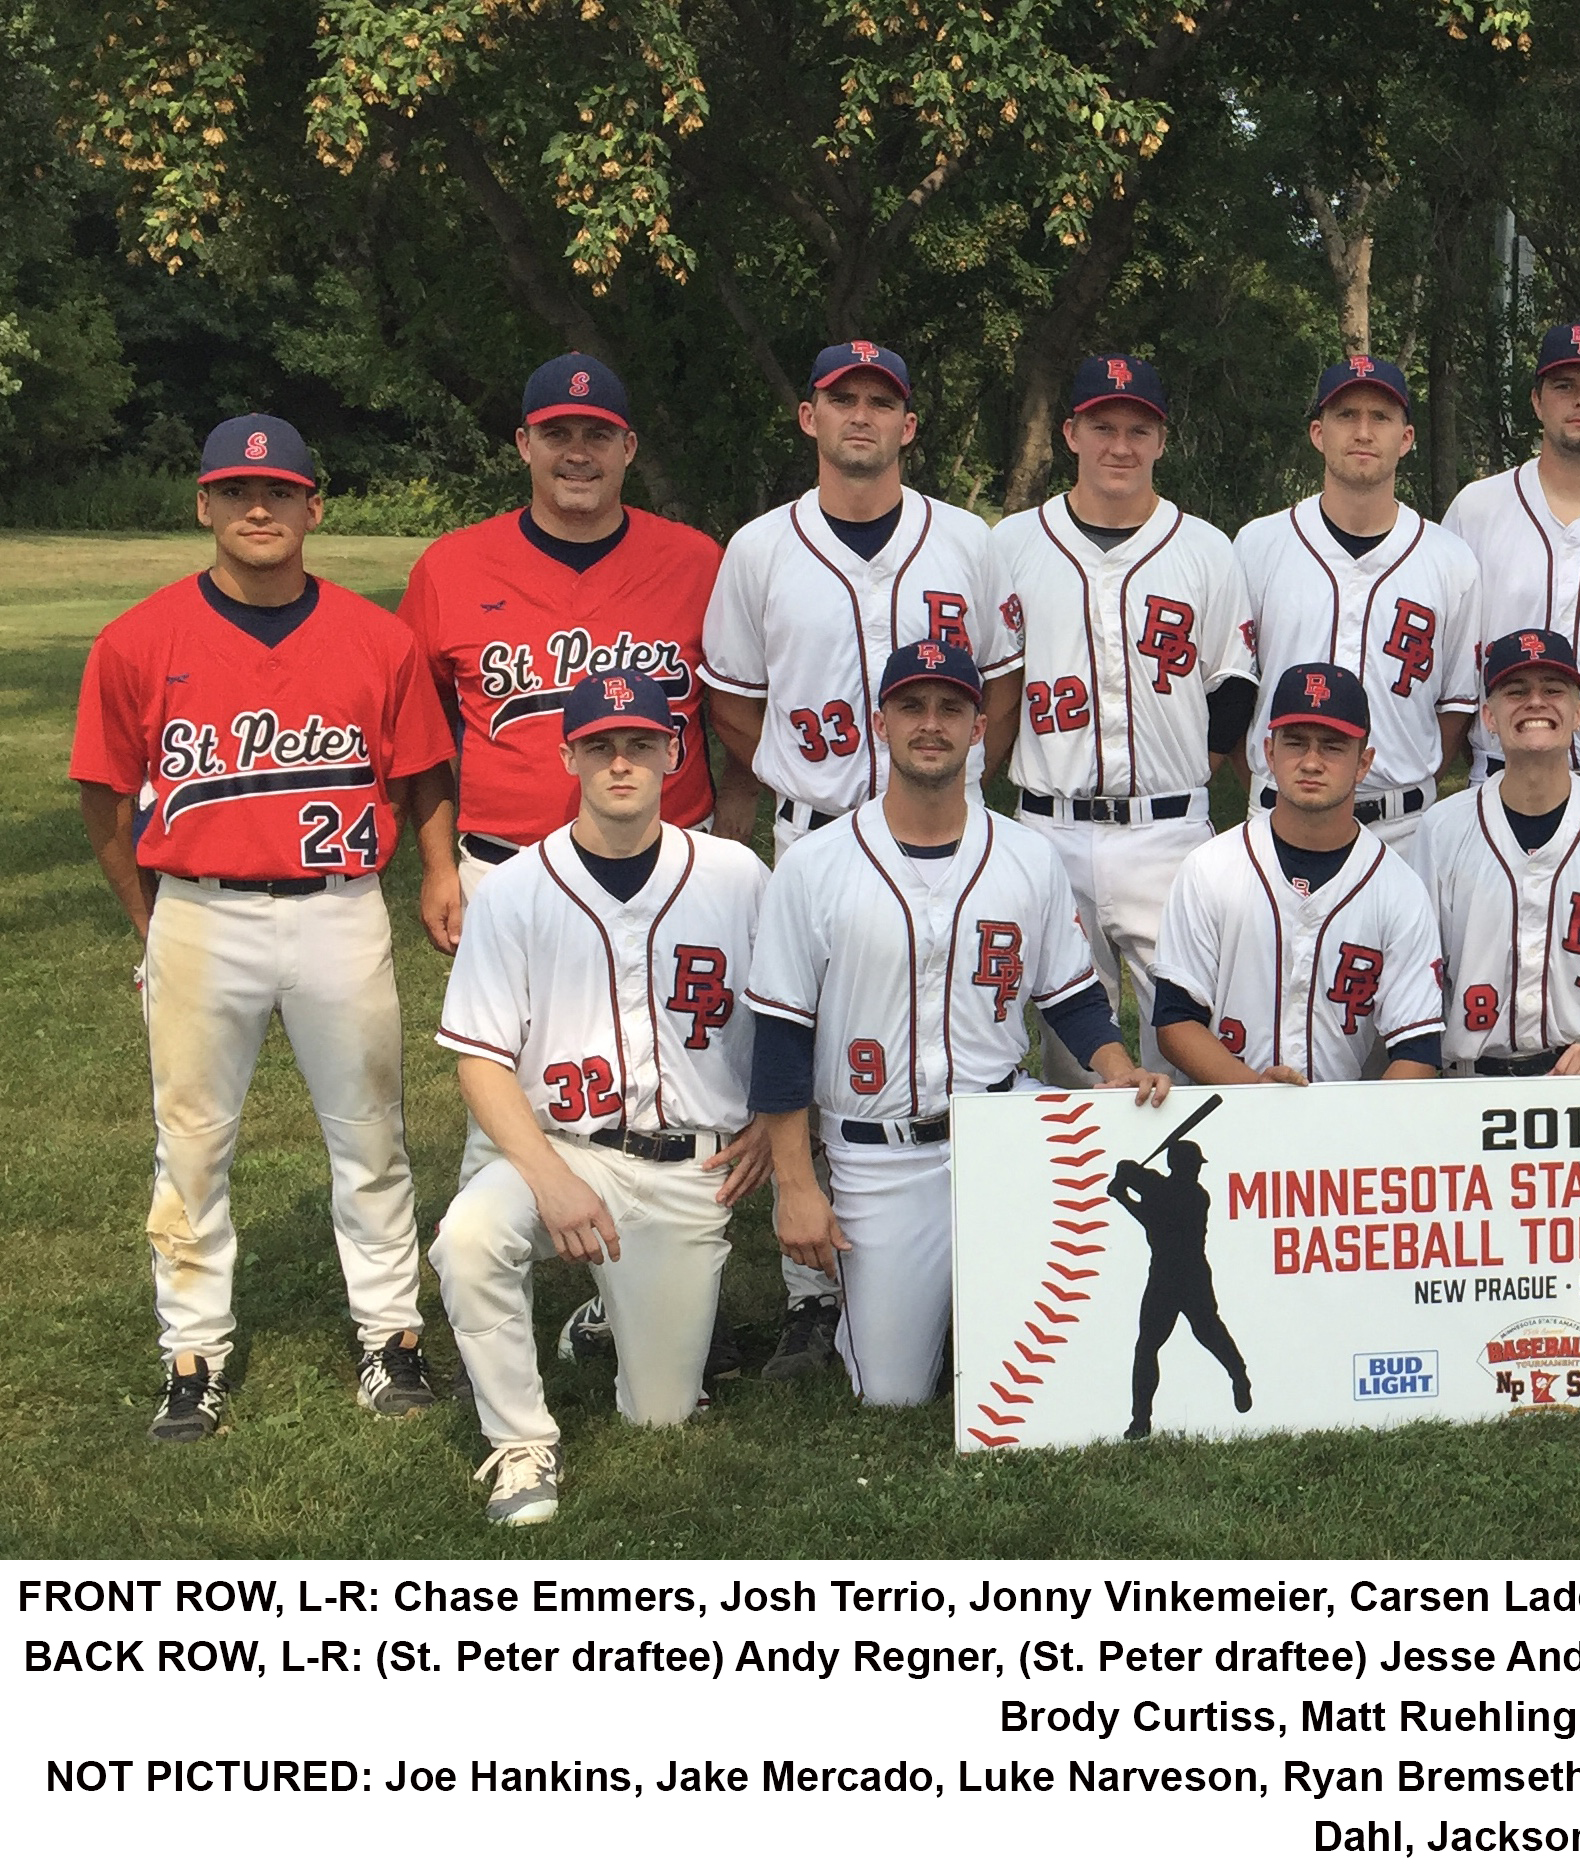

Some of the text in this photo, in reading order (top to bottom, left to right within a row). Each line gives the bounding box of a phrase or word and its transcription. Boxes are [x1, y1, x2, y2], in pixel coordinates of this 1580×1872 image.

[568, 371, 590, 397] S
[244, 431, 268, 460] S
[923, 590, 972, 655] B
[1137, 595, 1197, 695] BP
[1383, 597, 1437, 698] BP
[480, 627, 686, 699] St. Peter
[790, 699, 860, 763] 33
[1027, 676, 1090, 736] 22
[160, 709, 369, 780] St. Peter
[298, 801, 379, 868] 24
[667, 944, 734, 1050] BP
[972, 920, 1024, 1023] BP
[1327, 942, 1384, 1035] BP
[1463, 984, 1498, 1031] 8
[544, 1055, 623, 1123] 32
[848, 1038, 886, 1095] 9
[1228, 1164, 1492, 1220] MINNESOTA
[1273, 1220, 1504, 1275] BASEBALL
[1414, 1278, 1466, 1304] NEW
[1475, 1275, 1557, 1301] PRAGUE
[1359, 1375, 1433, 1395] LIGHT
[1369, 1356, 1423, 1376] BUD
[1515, 1359, 1580, 1369] TOURNAMENT
